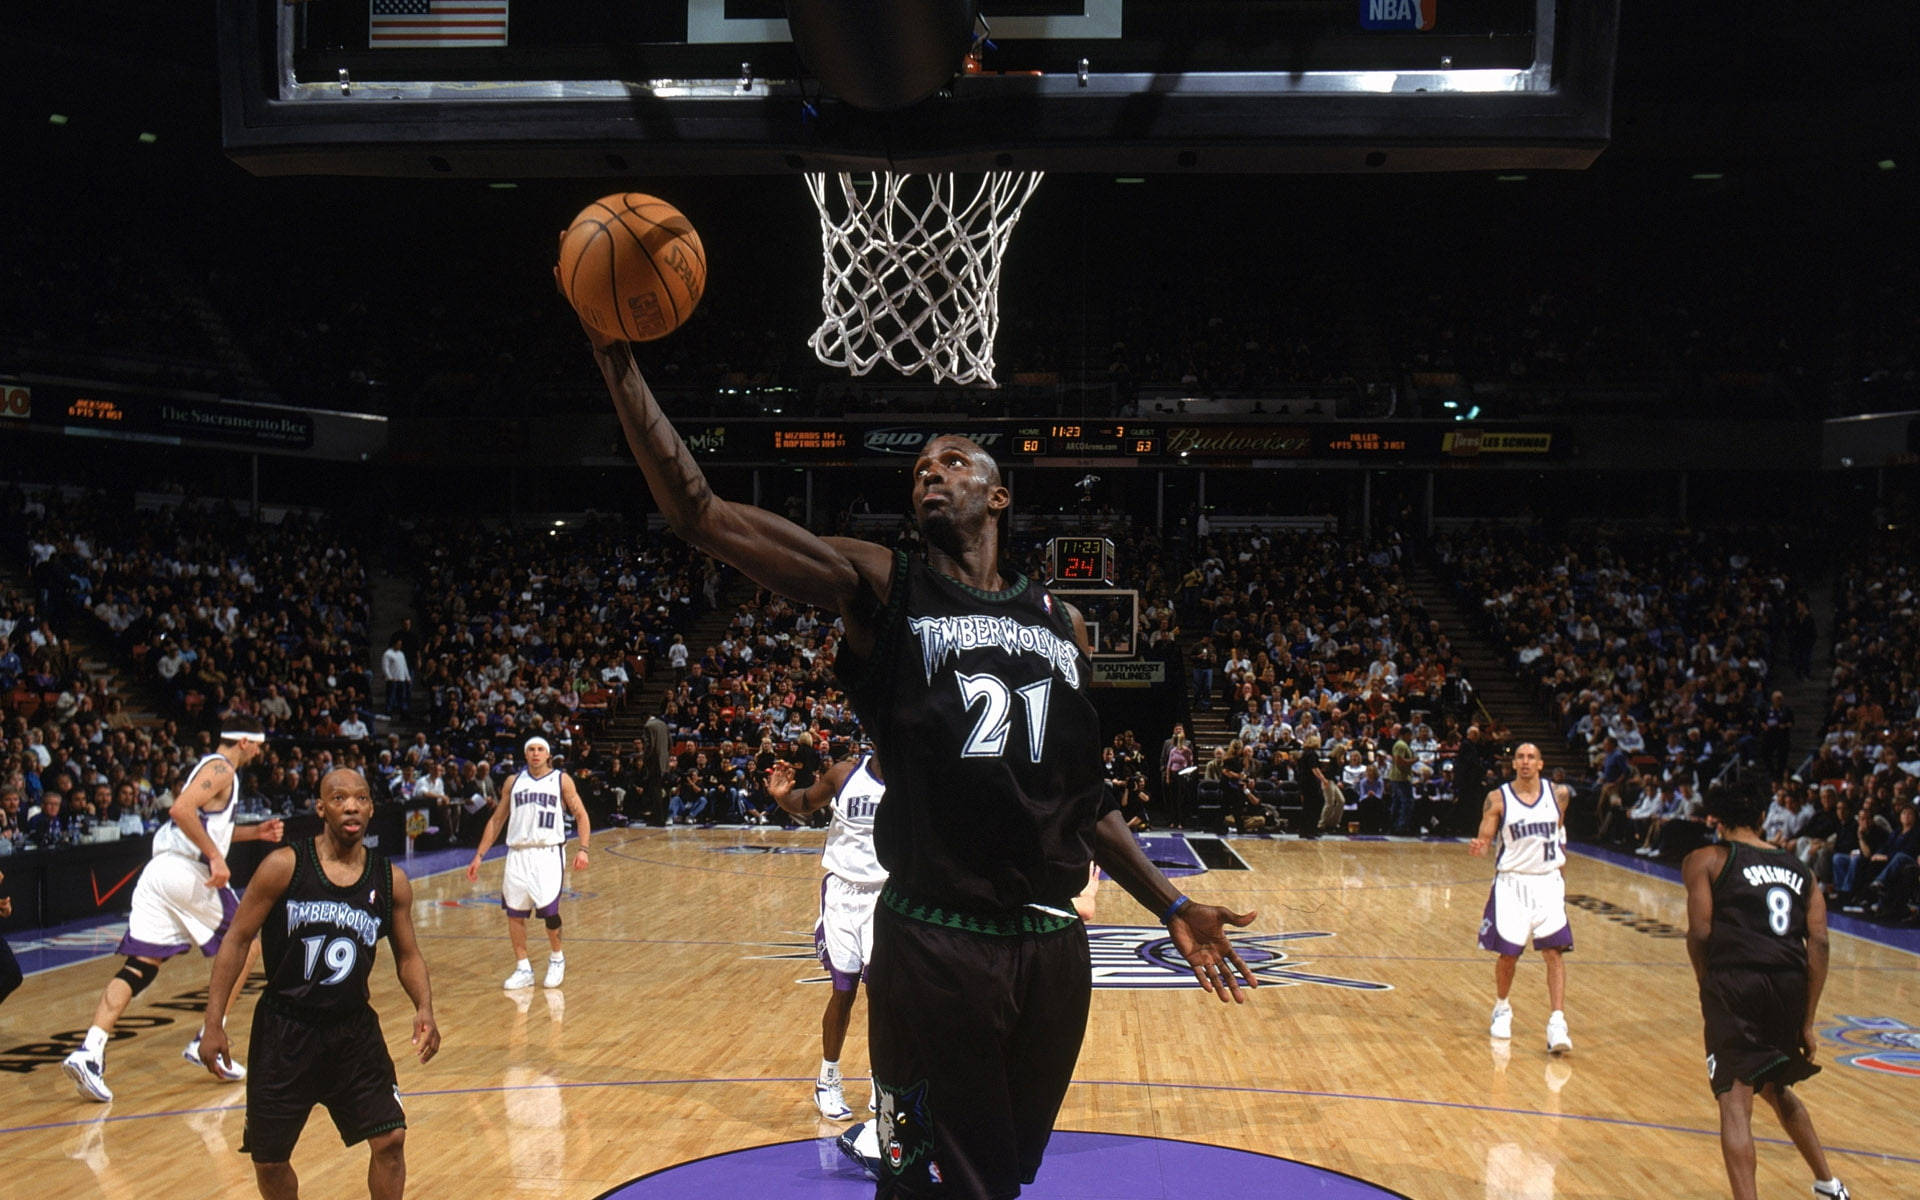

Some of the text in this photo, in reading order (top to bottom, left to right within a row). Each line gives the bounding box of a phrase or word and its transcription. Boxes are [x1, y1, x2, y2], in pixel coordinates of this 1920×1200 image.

[1369, 0, 1411, 20] NBA
[191, 410, 279, 430] Sacramento
[689, 428, 726, 450] Mist
[868, 432, 923, 446] BUD
[1052, 425, 1081, 438] 11:23
[1116, 425, 1124, 437] 3
[1167, 428, 1312, 452] Budweiser
[1024, 440, 1039, 451] 60
[1063, 541, 1100, 554] 11:23
[1064, 557, 1095, 578] 24
[907, 615, 1080, 689] TIMBERWOLVES
[1097, 663, 1161, 672] SOUTHWEST
[1105, 672, 1152, 680] AIRLINES
[954, 670, 1052, 763] 21
[514, 788, 557, 808] Kings
[537, 811, 555, 829] 10
[1543, 841, 1556, 861] 13
[1743, 865, 1804, 895] SPREWELL
[1766, 887, 1793, 936] 8
[286, 899, 382, 947] TIMBERWOLVES
[301, 934, 357, 985] 19
